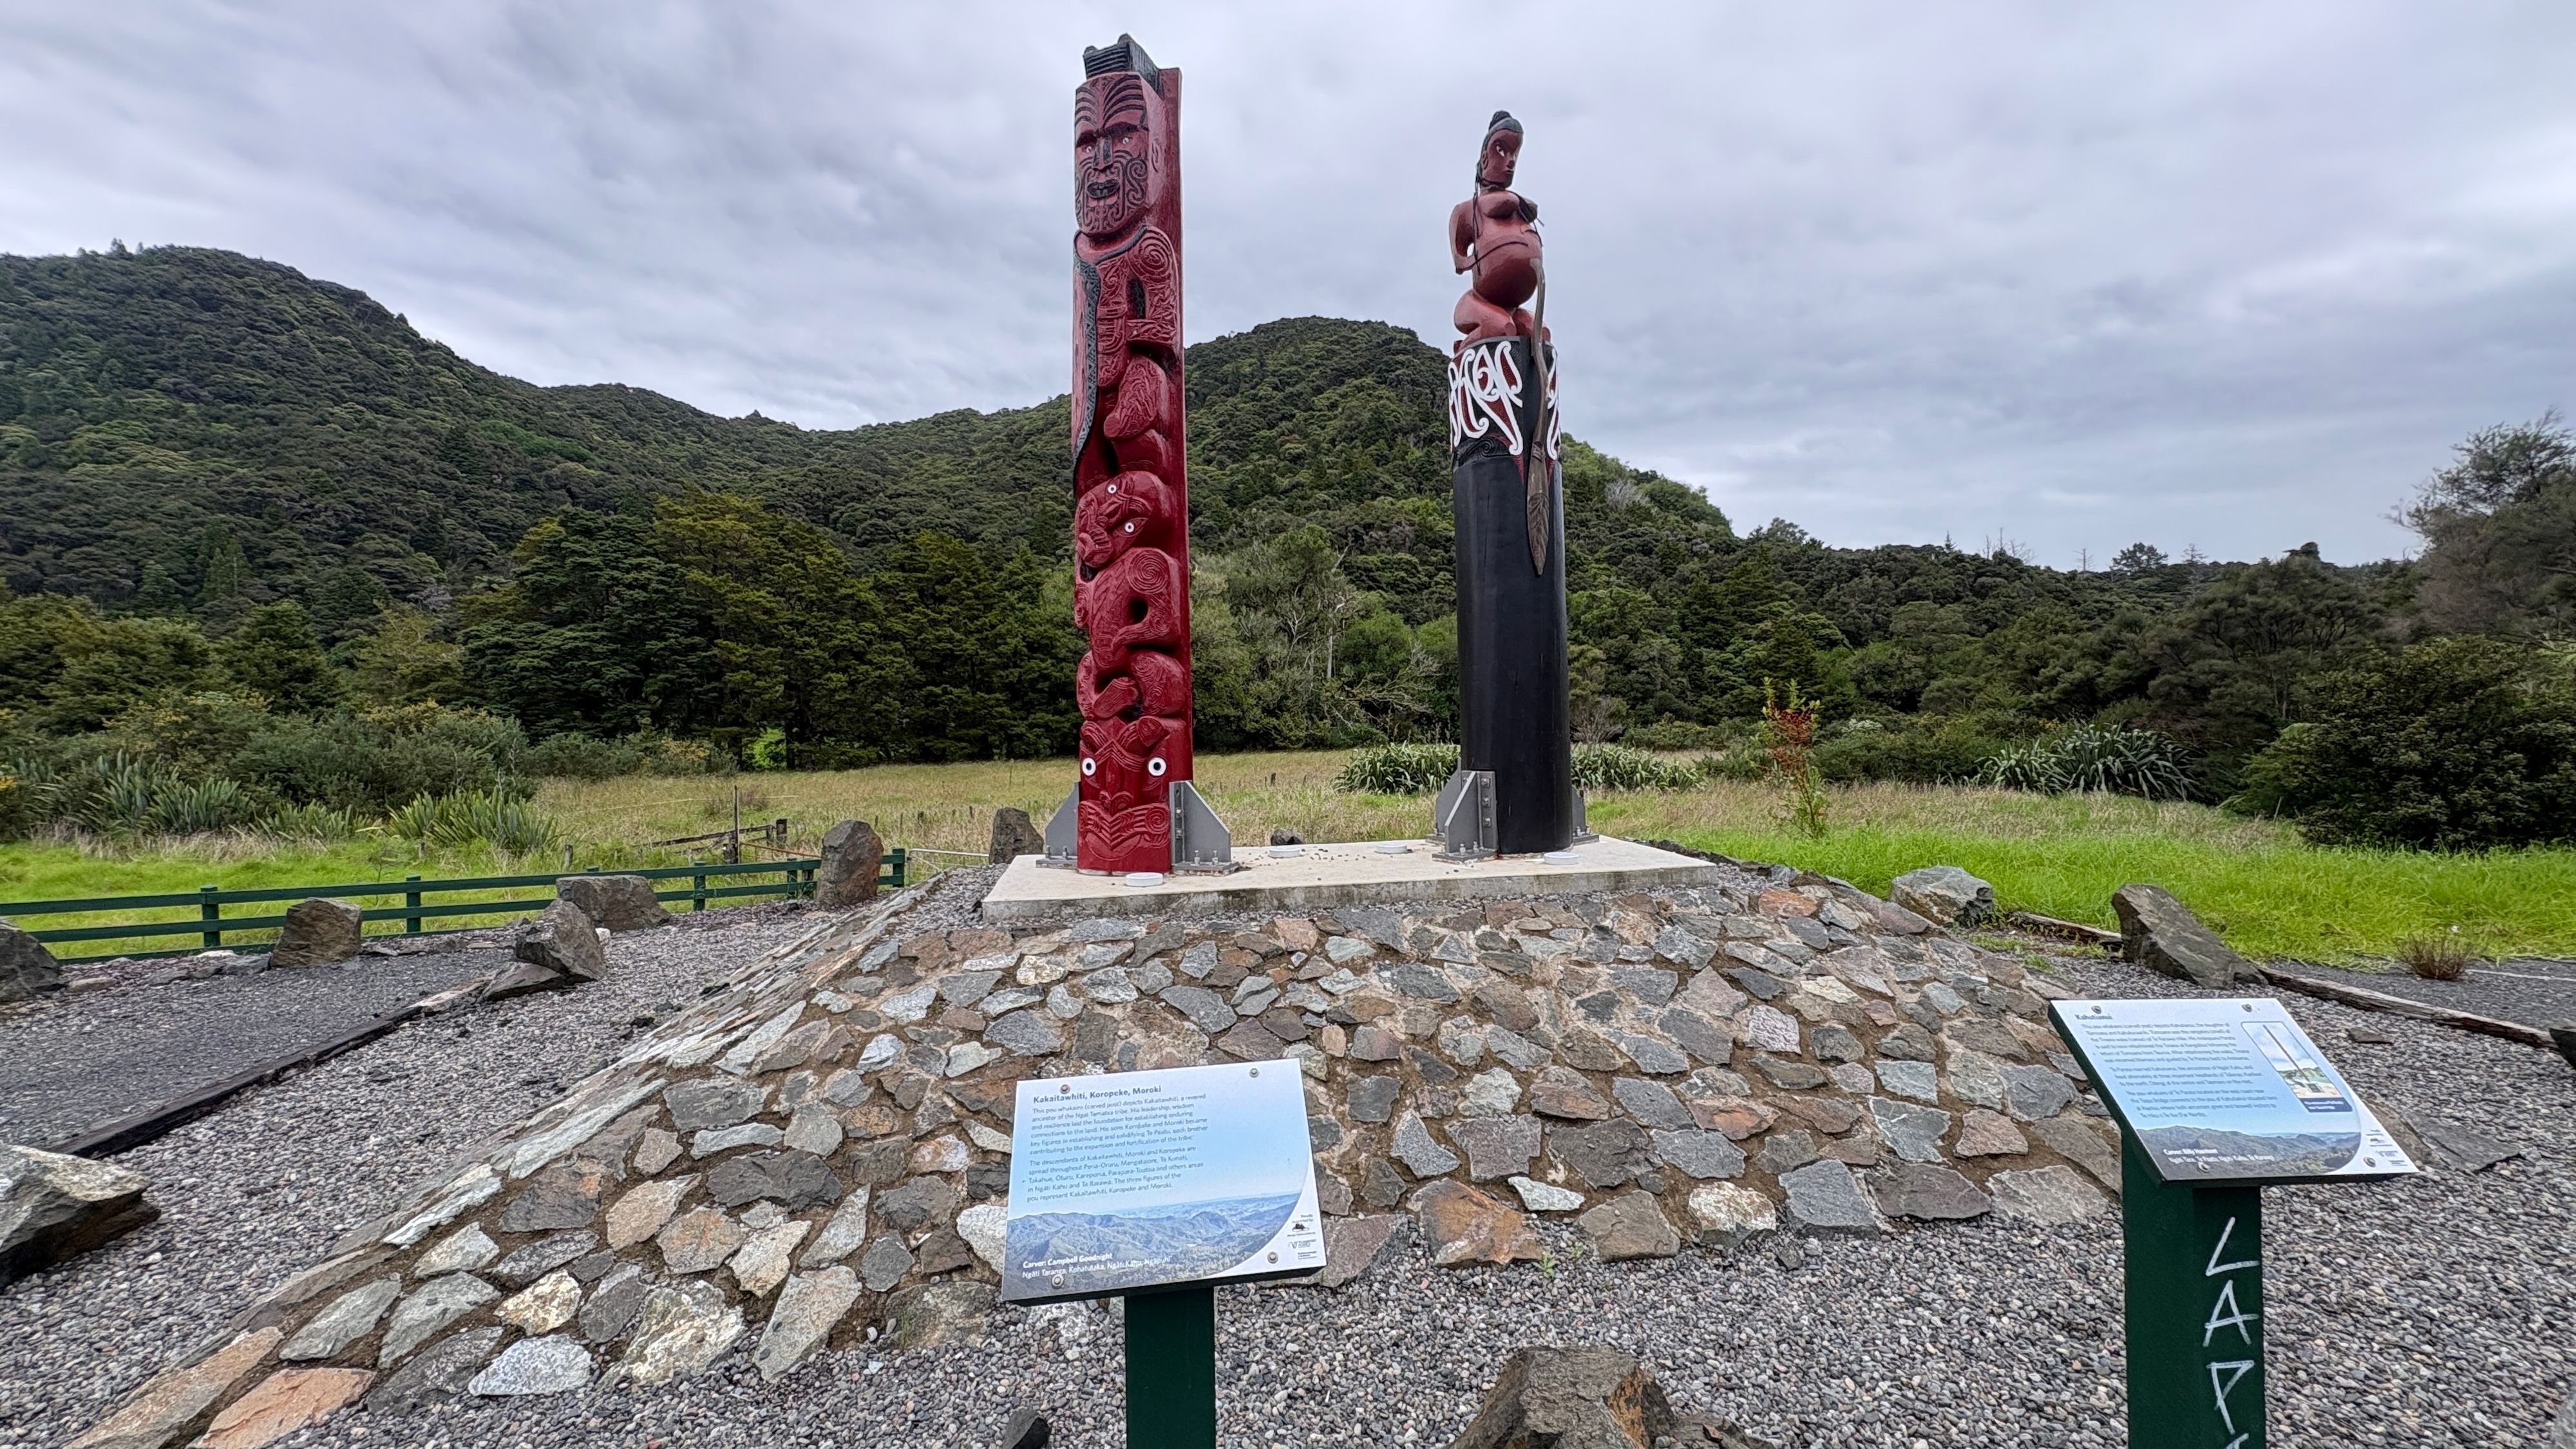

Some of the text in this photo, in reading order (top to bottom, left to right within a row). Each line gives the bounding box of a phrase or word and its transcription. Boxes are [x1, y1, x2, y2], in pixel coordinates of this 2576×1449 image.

[1033, 1085, 1161, 1103] Kakaitawhiti, Koropeke, Moroki
[1031, 1130, 1066, 1139] connections
[1069, 1135, 1103, 1143] establishing
[1042, 1157, 1079, 1166] descendants
[1050, 1165, 1082, 1173] throughout
[1040, 1193, 1068, 1201] represent
[1047, 1256, 1077, 1266] Campbell
[1079, 1253, 1113, 1262] Goodnight
